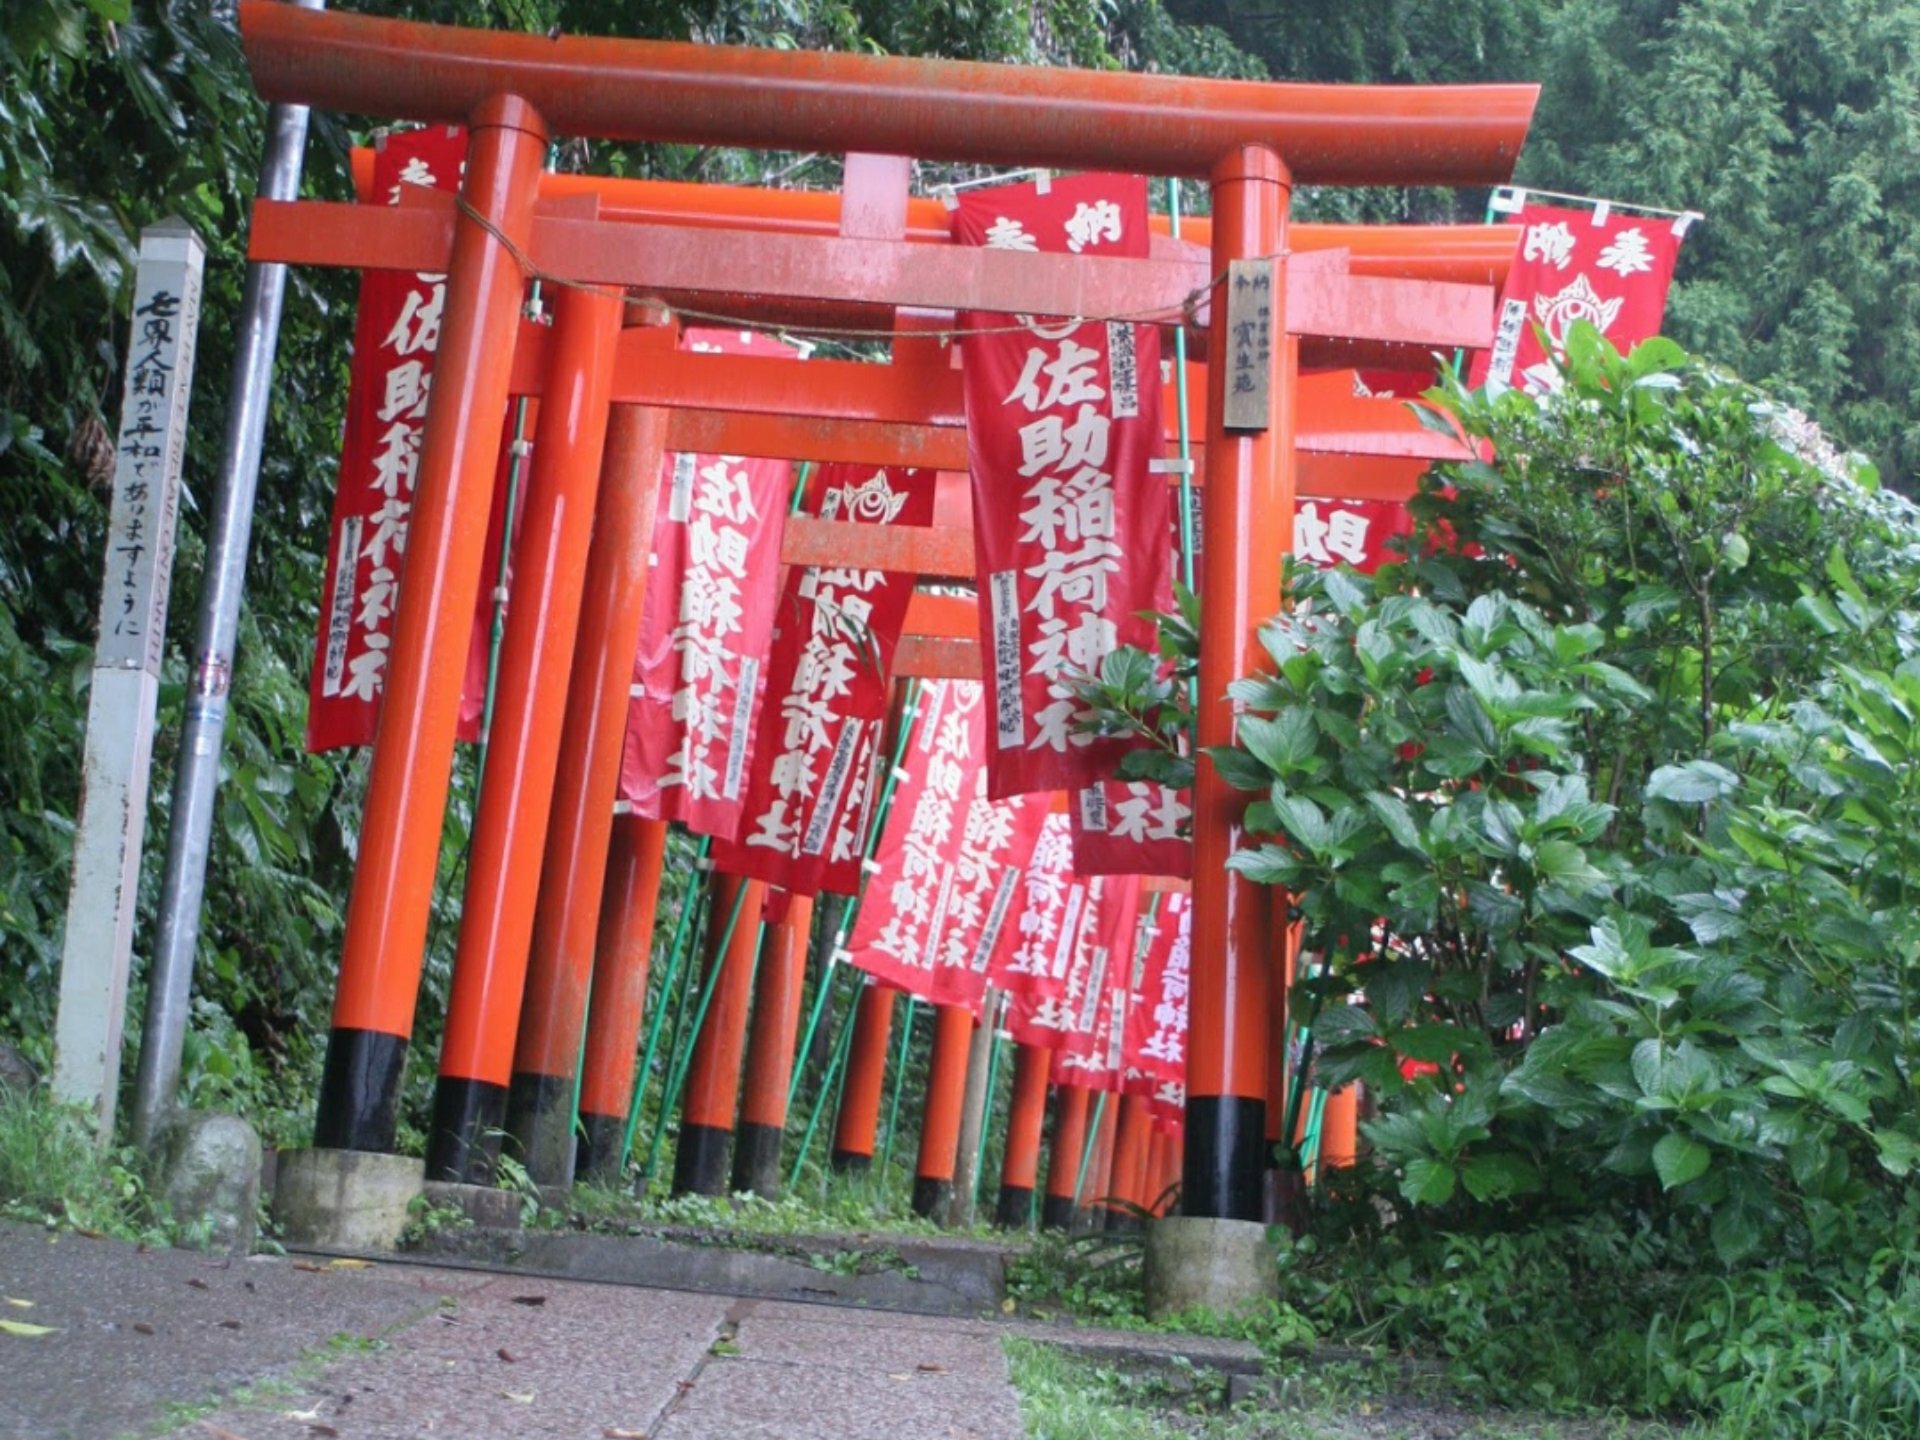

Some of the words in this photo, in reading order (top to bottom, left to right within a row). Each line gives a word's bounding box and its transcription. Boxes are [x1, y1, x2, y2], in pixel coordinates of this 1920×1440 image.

[114, 290, 181, 637] 世界人類が平和でありますように
[1002, 340, 1135, 752] 佐助稲荷神社
